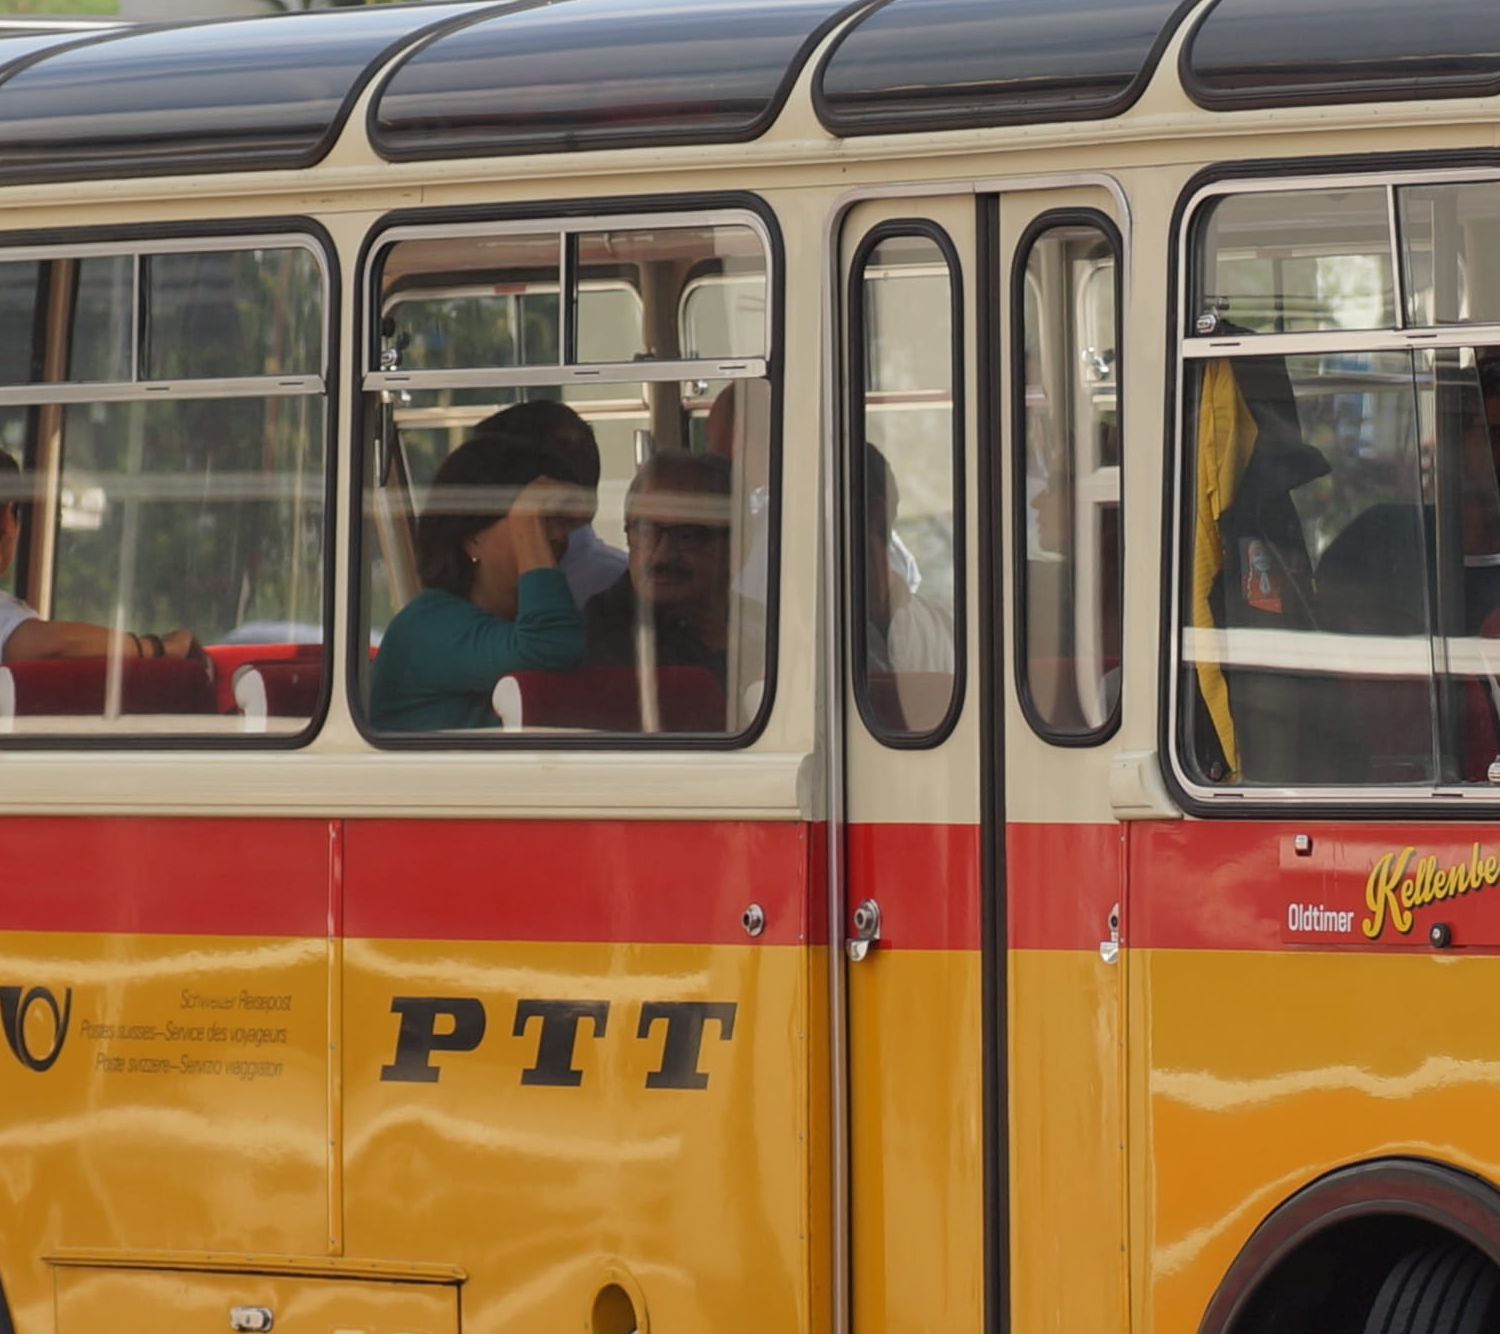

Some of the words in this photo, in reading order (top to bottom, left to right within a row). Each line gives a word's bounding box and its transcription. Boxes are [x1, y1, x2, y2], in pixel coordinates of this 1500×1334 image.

[1287, 903, 1355, 933] Oldtimer
[206, 1022, 228, 1043] des
[230, 1024, 288, 1048] voyageurs
[380, 996, 738, 1091] PTT
